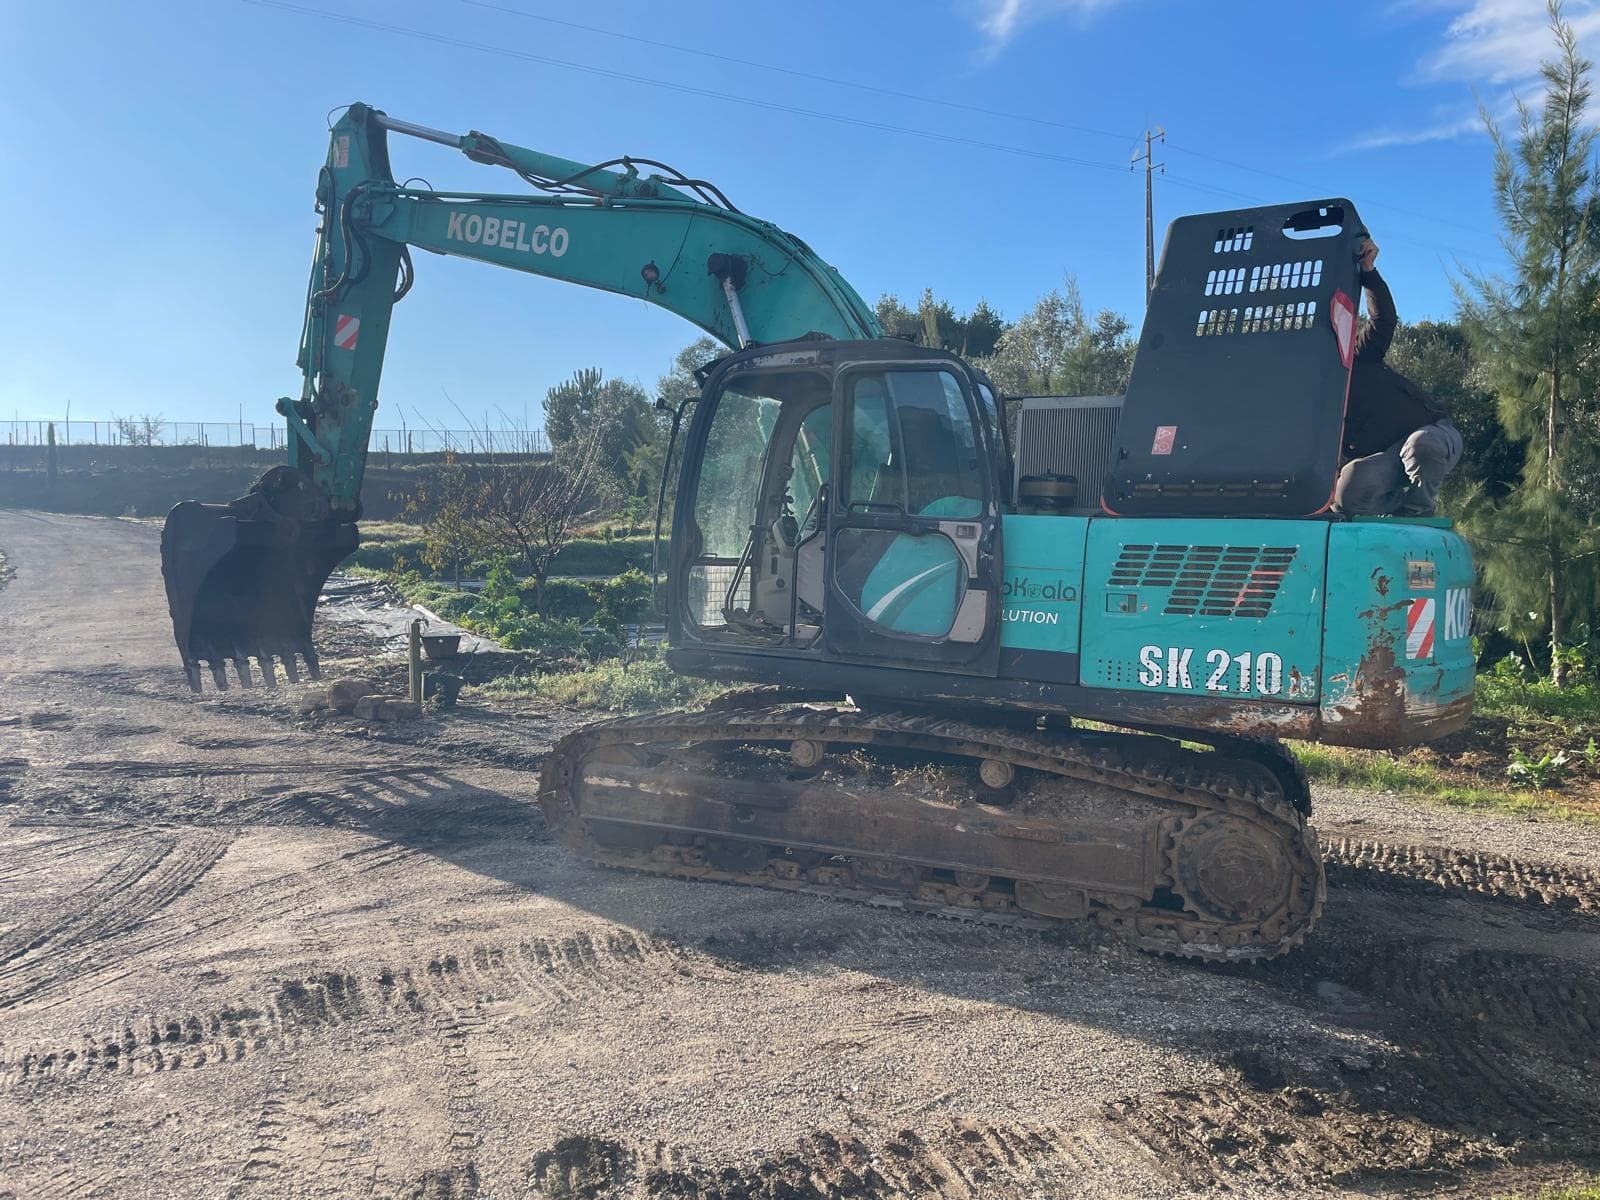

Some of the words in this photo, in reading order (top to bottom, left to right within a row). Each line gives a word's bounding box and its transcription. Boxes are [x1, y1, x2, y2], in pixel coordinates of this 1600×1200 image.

[446, 211, 569, 258] KOBELCO
[1001, 609, 1059, 625] LUTION
[1139, 645, 1194, 689] SK
[1205, 648, 1283, 695] 210
